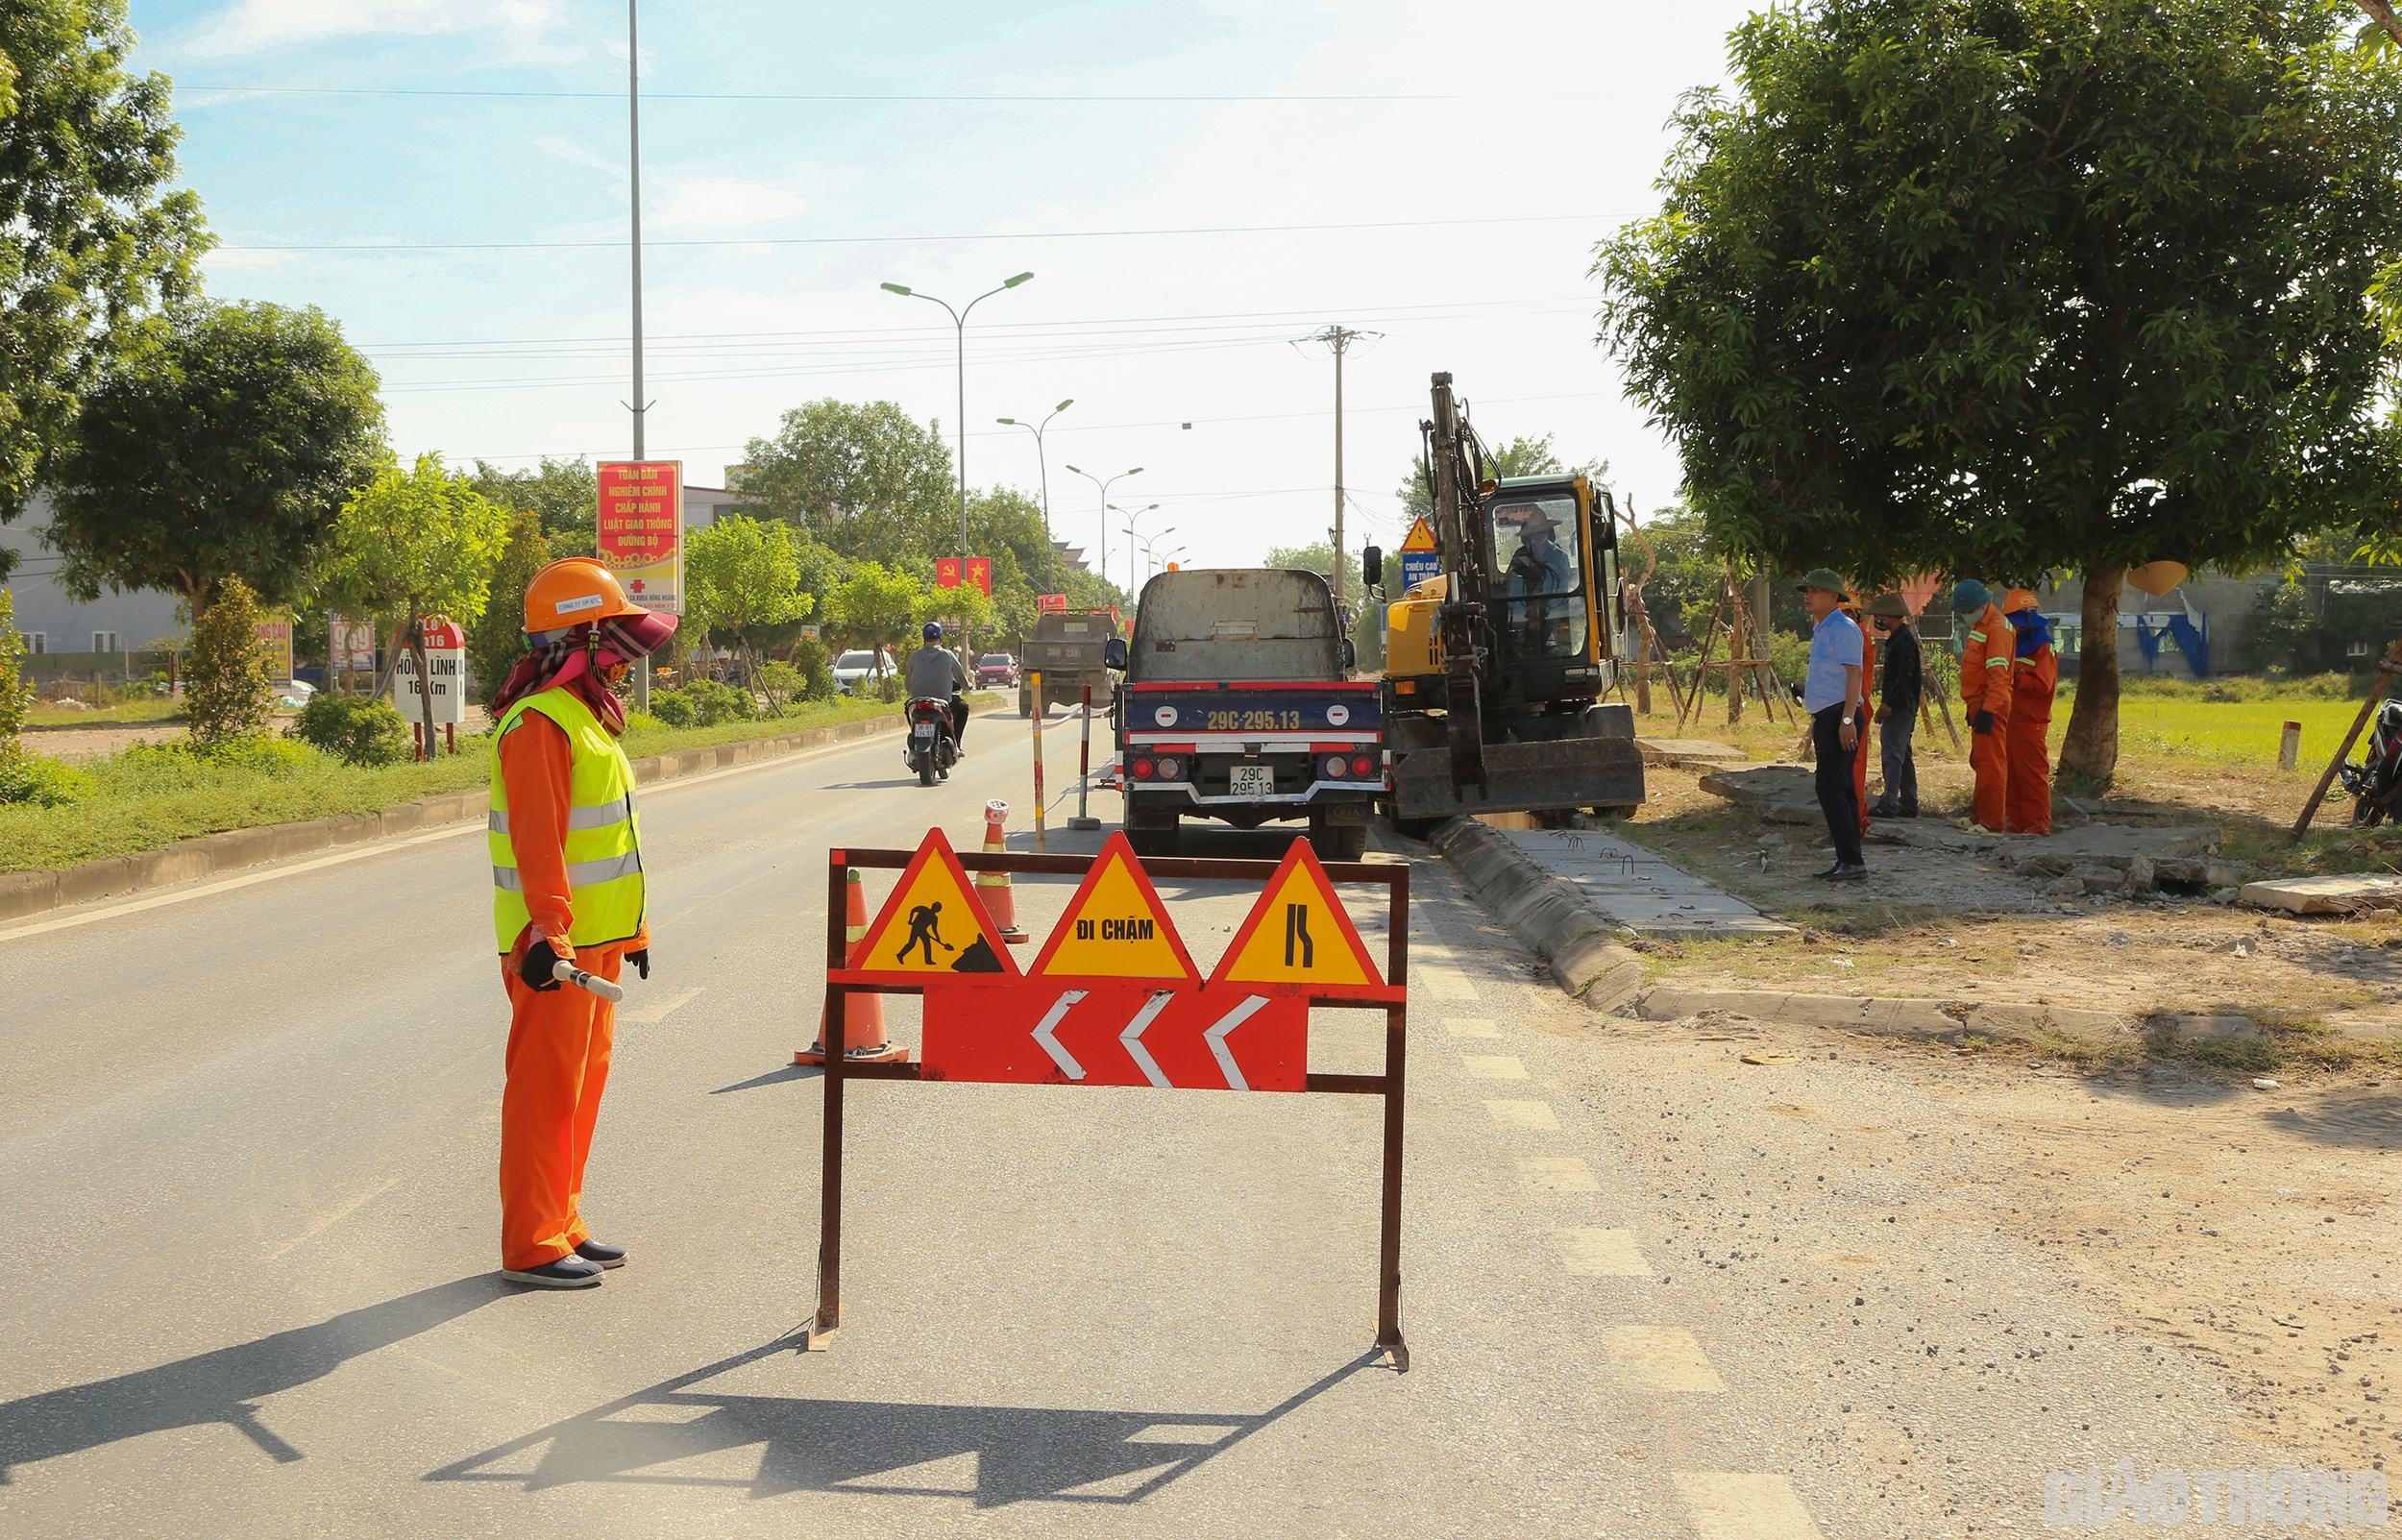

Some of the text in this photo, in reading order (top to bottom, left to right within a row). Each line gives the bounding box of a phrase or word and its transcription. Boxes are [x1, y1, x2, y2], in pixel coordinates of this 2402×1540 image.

[618, 467, 657, 480] TOÀN DÂN
[609, 482, 667, 497] NGHIÊM CHỈNH
[615, 500, 661, 513] CHẤP HÀNH
[603, 517, 673, 532] LUẬT GIAO THÔNG
[618, 533, 658, 549] ĐƯỜNG BỘ
[1425, 562, 1437, 571] CAO
[1408, 573, 1417, 581] AN
[430, 655, 455, 675] LĨNH
[1240, 768, 1263, 781] 29C
[1339, 808, 1360, 817] KIA
[1076, 915, 1154, 944] ĐI CHẬM
